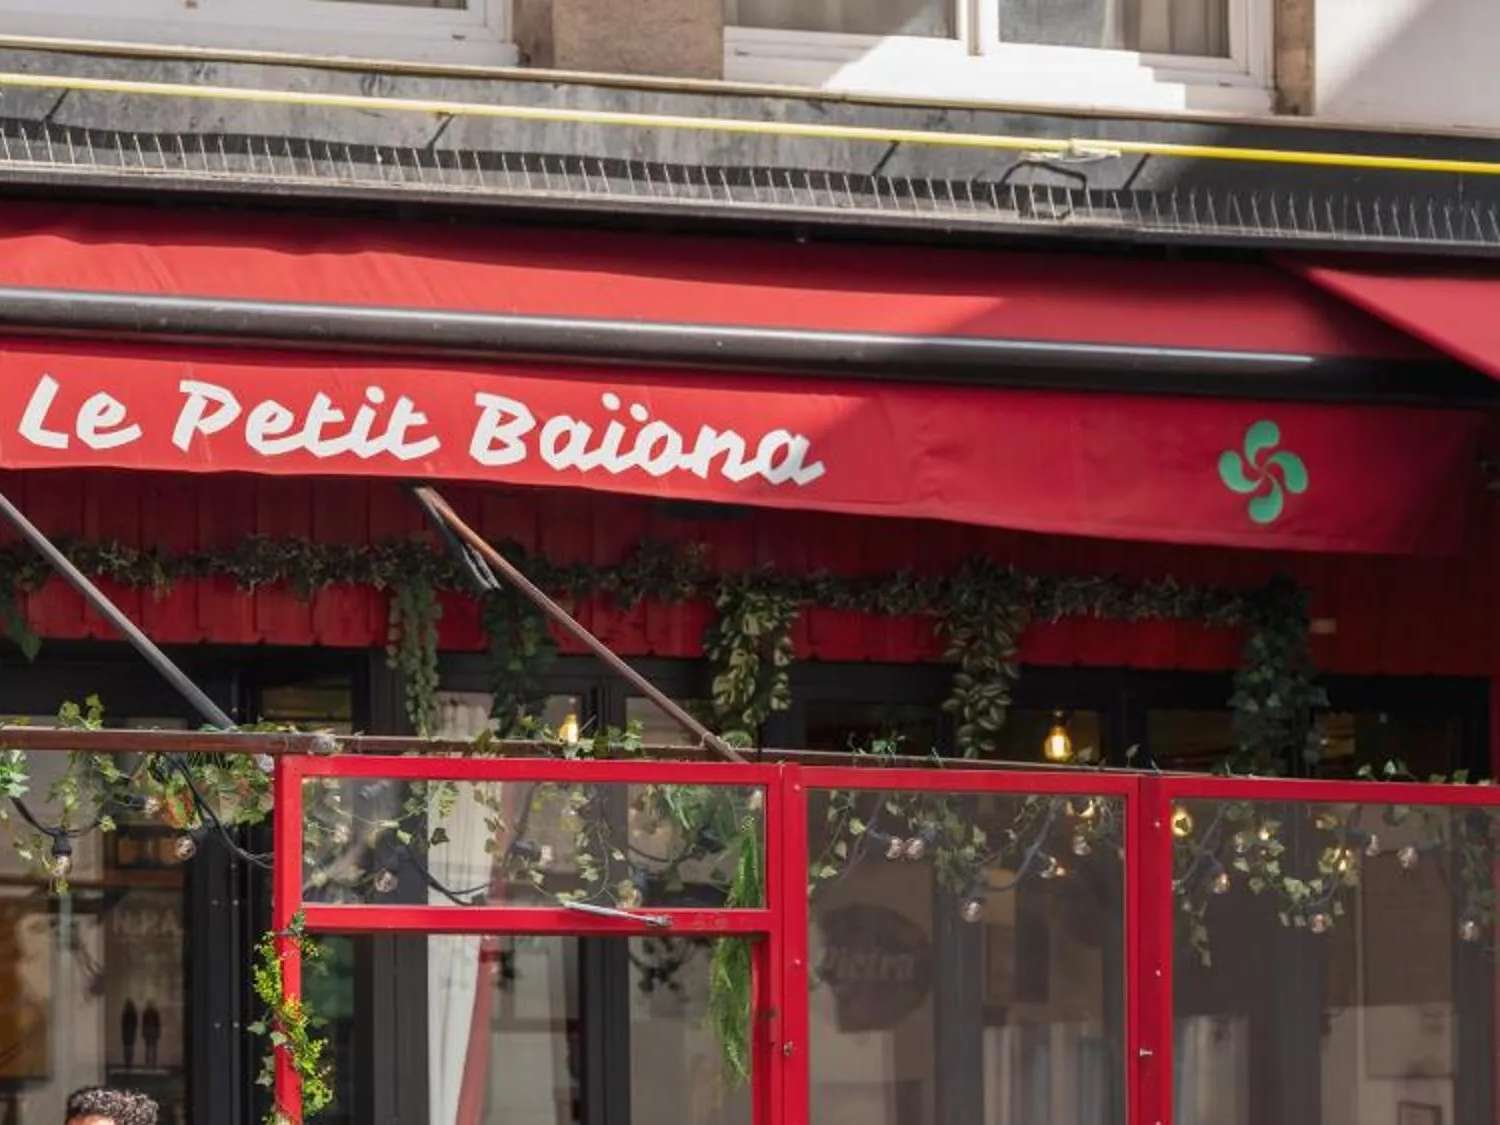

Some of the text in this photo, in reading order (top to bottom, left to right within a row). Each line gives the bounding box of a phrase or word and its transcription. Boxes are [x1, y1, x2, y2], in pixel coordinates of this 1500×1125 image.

[18, 373, 826, 487] Le Petit Baïona
